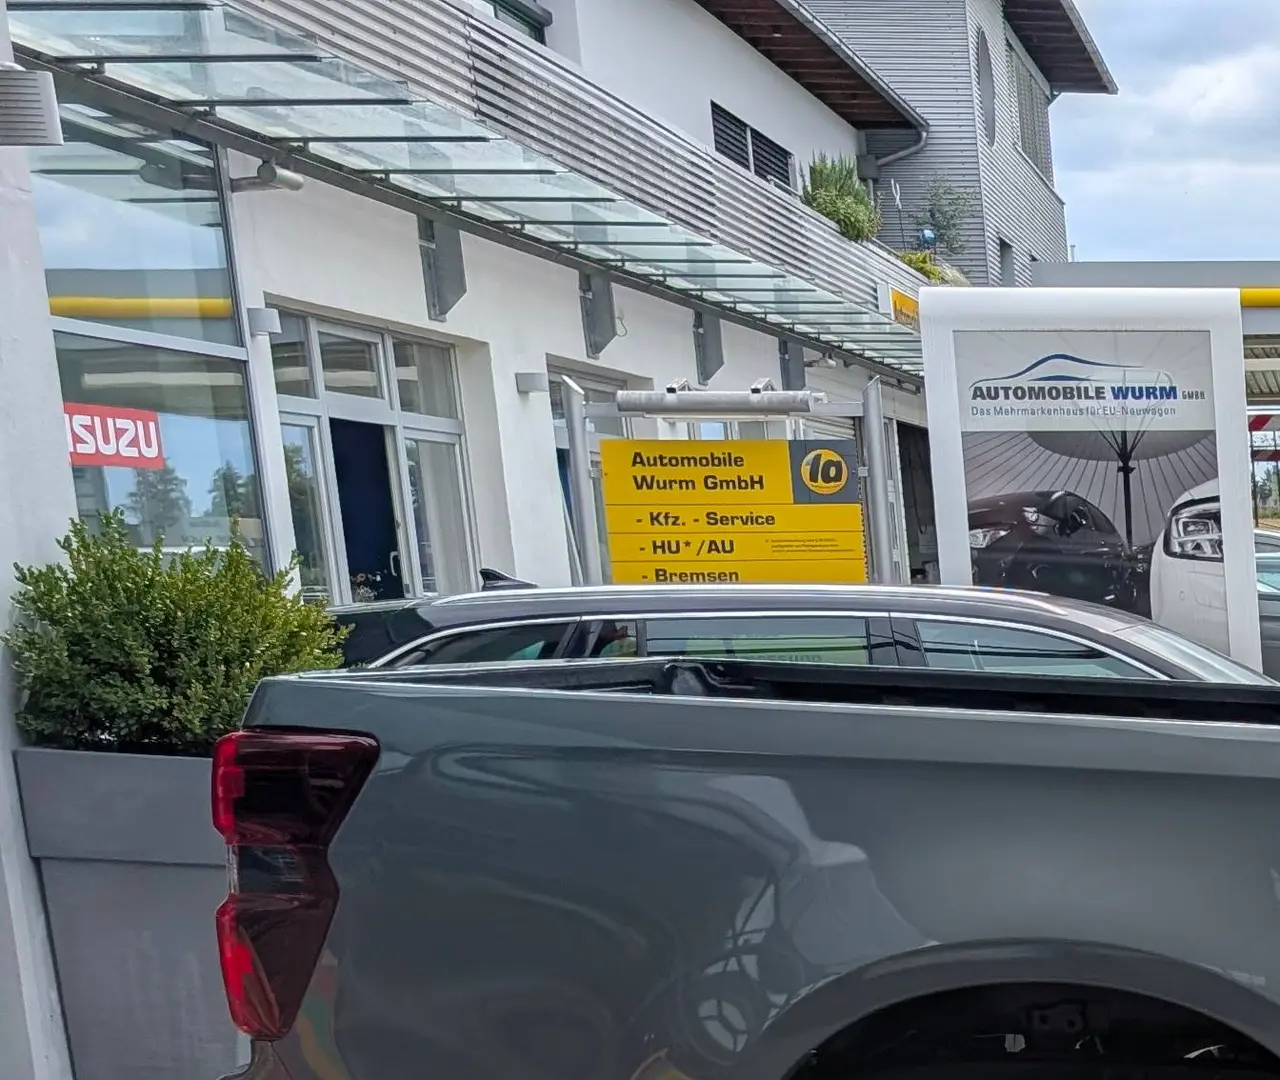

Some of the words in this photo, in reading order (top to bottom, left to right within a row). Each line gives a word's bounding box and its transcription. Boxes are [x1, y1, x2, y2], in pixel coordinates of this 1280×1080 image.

[971, 386, 1106, 400] AUTOMOBILE
[1110, 385, 1178, 400] WURM
[971, 406, 991, 416] Das
[993, 406, 1084, 416] Mehrmarkenhaus
[1086, 405, 1101, 416] für
[1102, 405, 1176, 417] EU-Neuwagen
[64, 413, 159, 458] ISUZU
[631, 451, 745, 467] Automobile
[632, 474, 696, 490] Wurm
[703, 474, 765, 490] GmbH
[649, 511, 686, 526] Kfz.
[705, 511, 776, 526] Service
[654, 568, 740, 583] Bremsen
